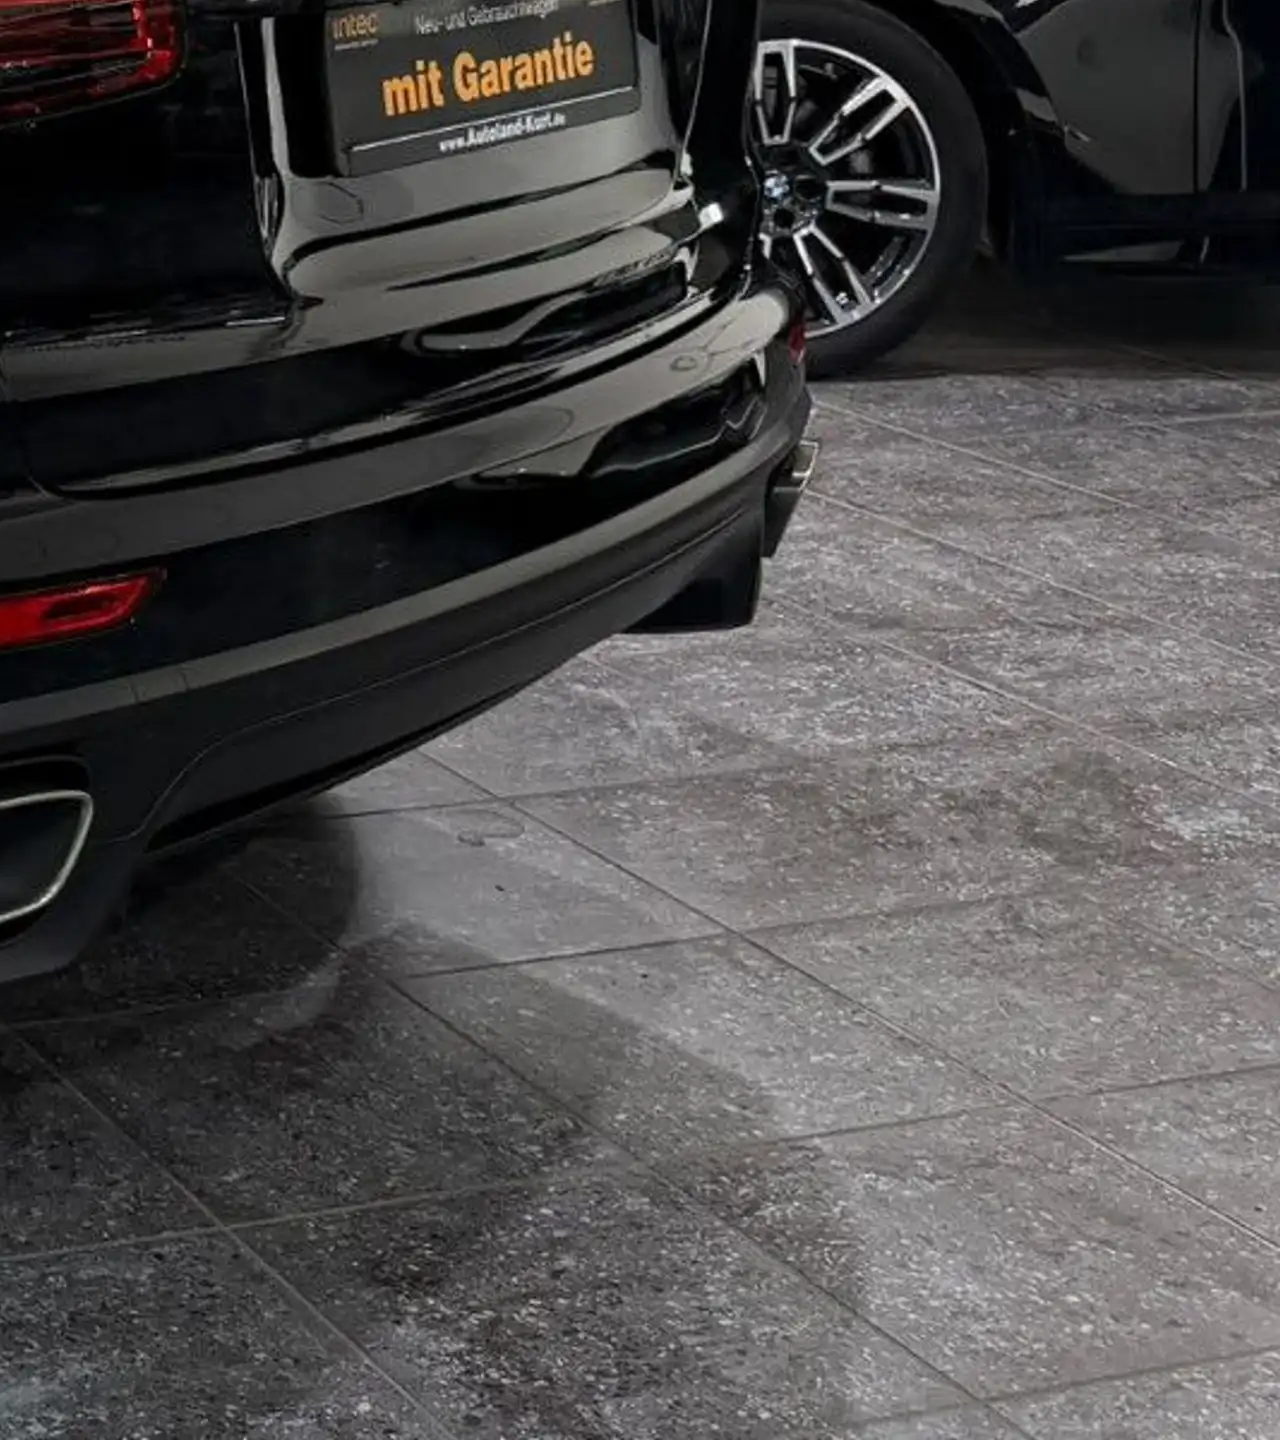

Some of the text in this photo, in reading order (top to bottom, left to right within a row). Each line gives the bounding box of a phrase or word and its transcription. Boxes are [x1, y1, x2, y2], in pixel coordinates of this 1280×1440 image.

[444, 8, 467, 32] und
[381, 30, 595, 117] mit Garantie
